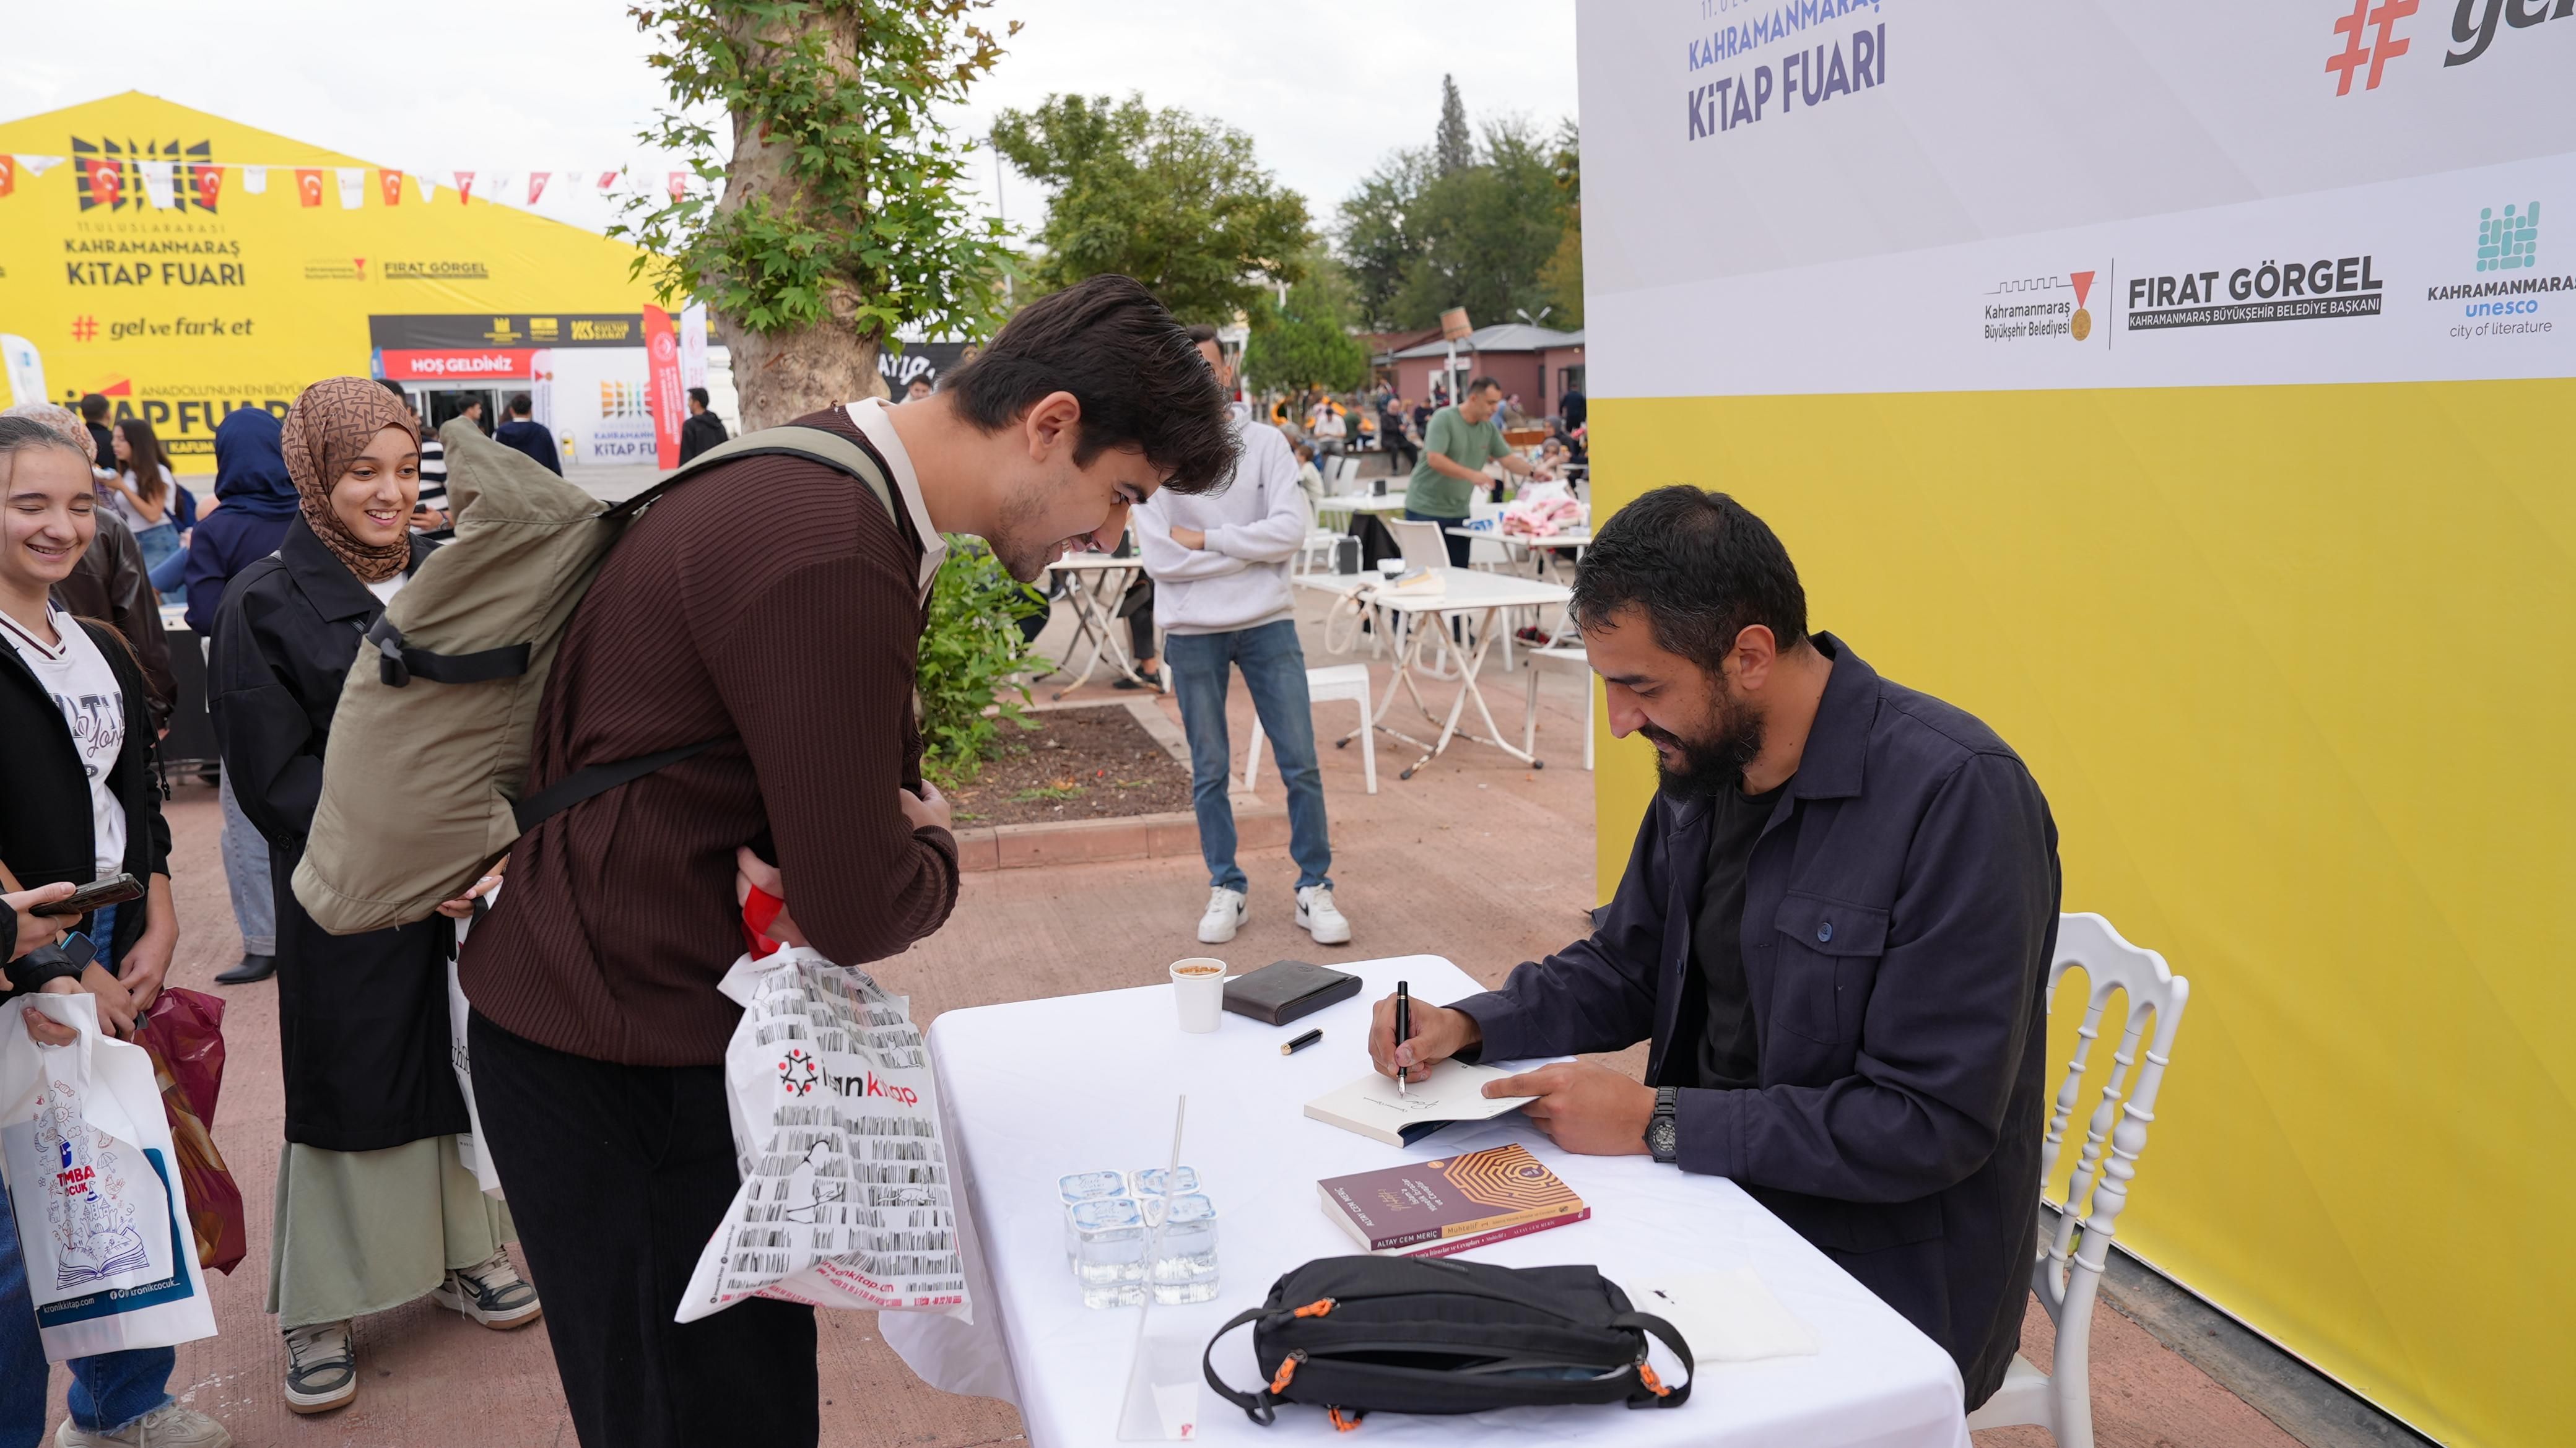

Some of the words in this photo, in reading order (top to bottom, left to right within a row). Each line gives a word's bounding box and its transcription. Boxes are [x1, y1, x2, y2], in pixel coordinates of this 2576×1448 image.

[1783, 22, 1886, 113] FUARI
[64, 238, 241, 258] KAHRAMANMARAŞ
[161, 262, 245, 285] FUARI
[384, 262, 424, 272] FIRAT
[430, 261, 488, 272] GÖRGEL
[2129, 271, 2219, 308] FIRAT
[2229, 255, 2383, 301] GÖRGEL
[2427, 275, 2576, 301] KAHRAMANMARA
[1985, 301, 2071, 319] Kahramanmaraş
[2130, 310, 2211, 327] KAHRAMANMARAŞ
[2213, 303, 2274, 321] BÜYÜKŞEHİR
[2277, 300, 2328, 318] BELEDİYE
[2330, 297, 2380, 314] BAŞKANI
[2465, 300, 2538, 318] unesco
[110, 316, 146, 341] gel
[149, 323, 171, 336] ve
[175, 316, 225, 336] fark
[231, 318, 255, 336] et
[1985, 322, 2027, 342] Büyükşehir
[2029, 319, 2070, 339] Belediyesi
[2450, 324, 2473, 340] city
[2475, 322, 2489, 336] of
[2492, 321, 2552, 336] literature
[411, 358, 445, 375] HOŞ
[446, 354, 513, 372] GELDİNİZ
[244, 384, 263, 396] EN
[1447, 1222, 1477, 1234] Muhtelif
[1377, 1238, 1398, 1248] ALTAY
[1399, 1235, 1414, 1243] CEM
[1416, 1230, 1437, 1239] MERİÇ
[43, 1297, 95, 1314] kronikkitap.com
